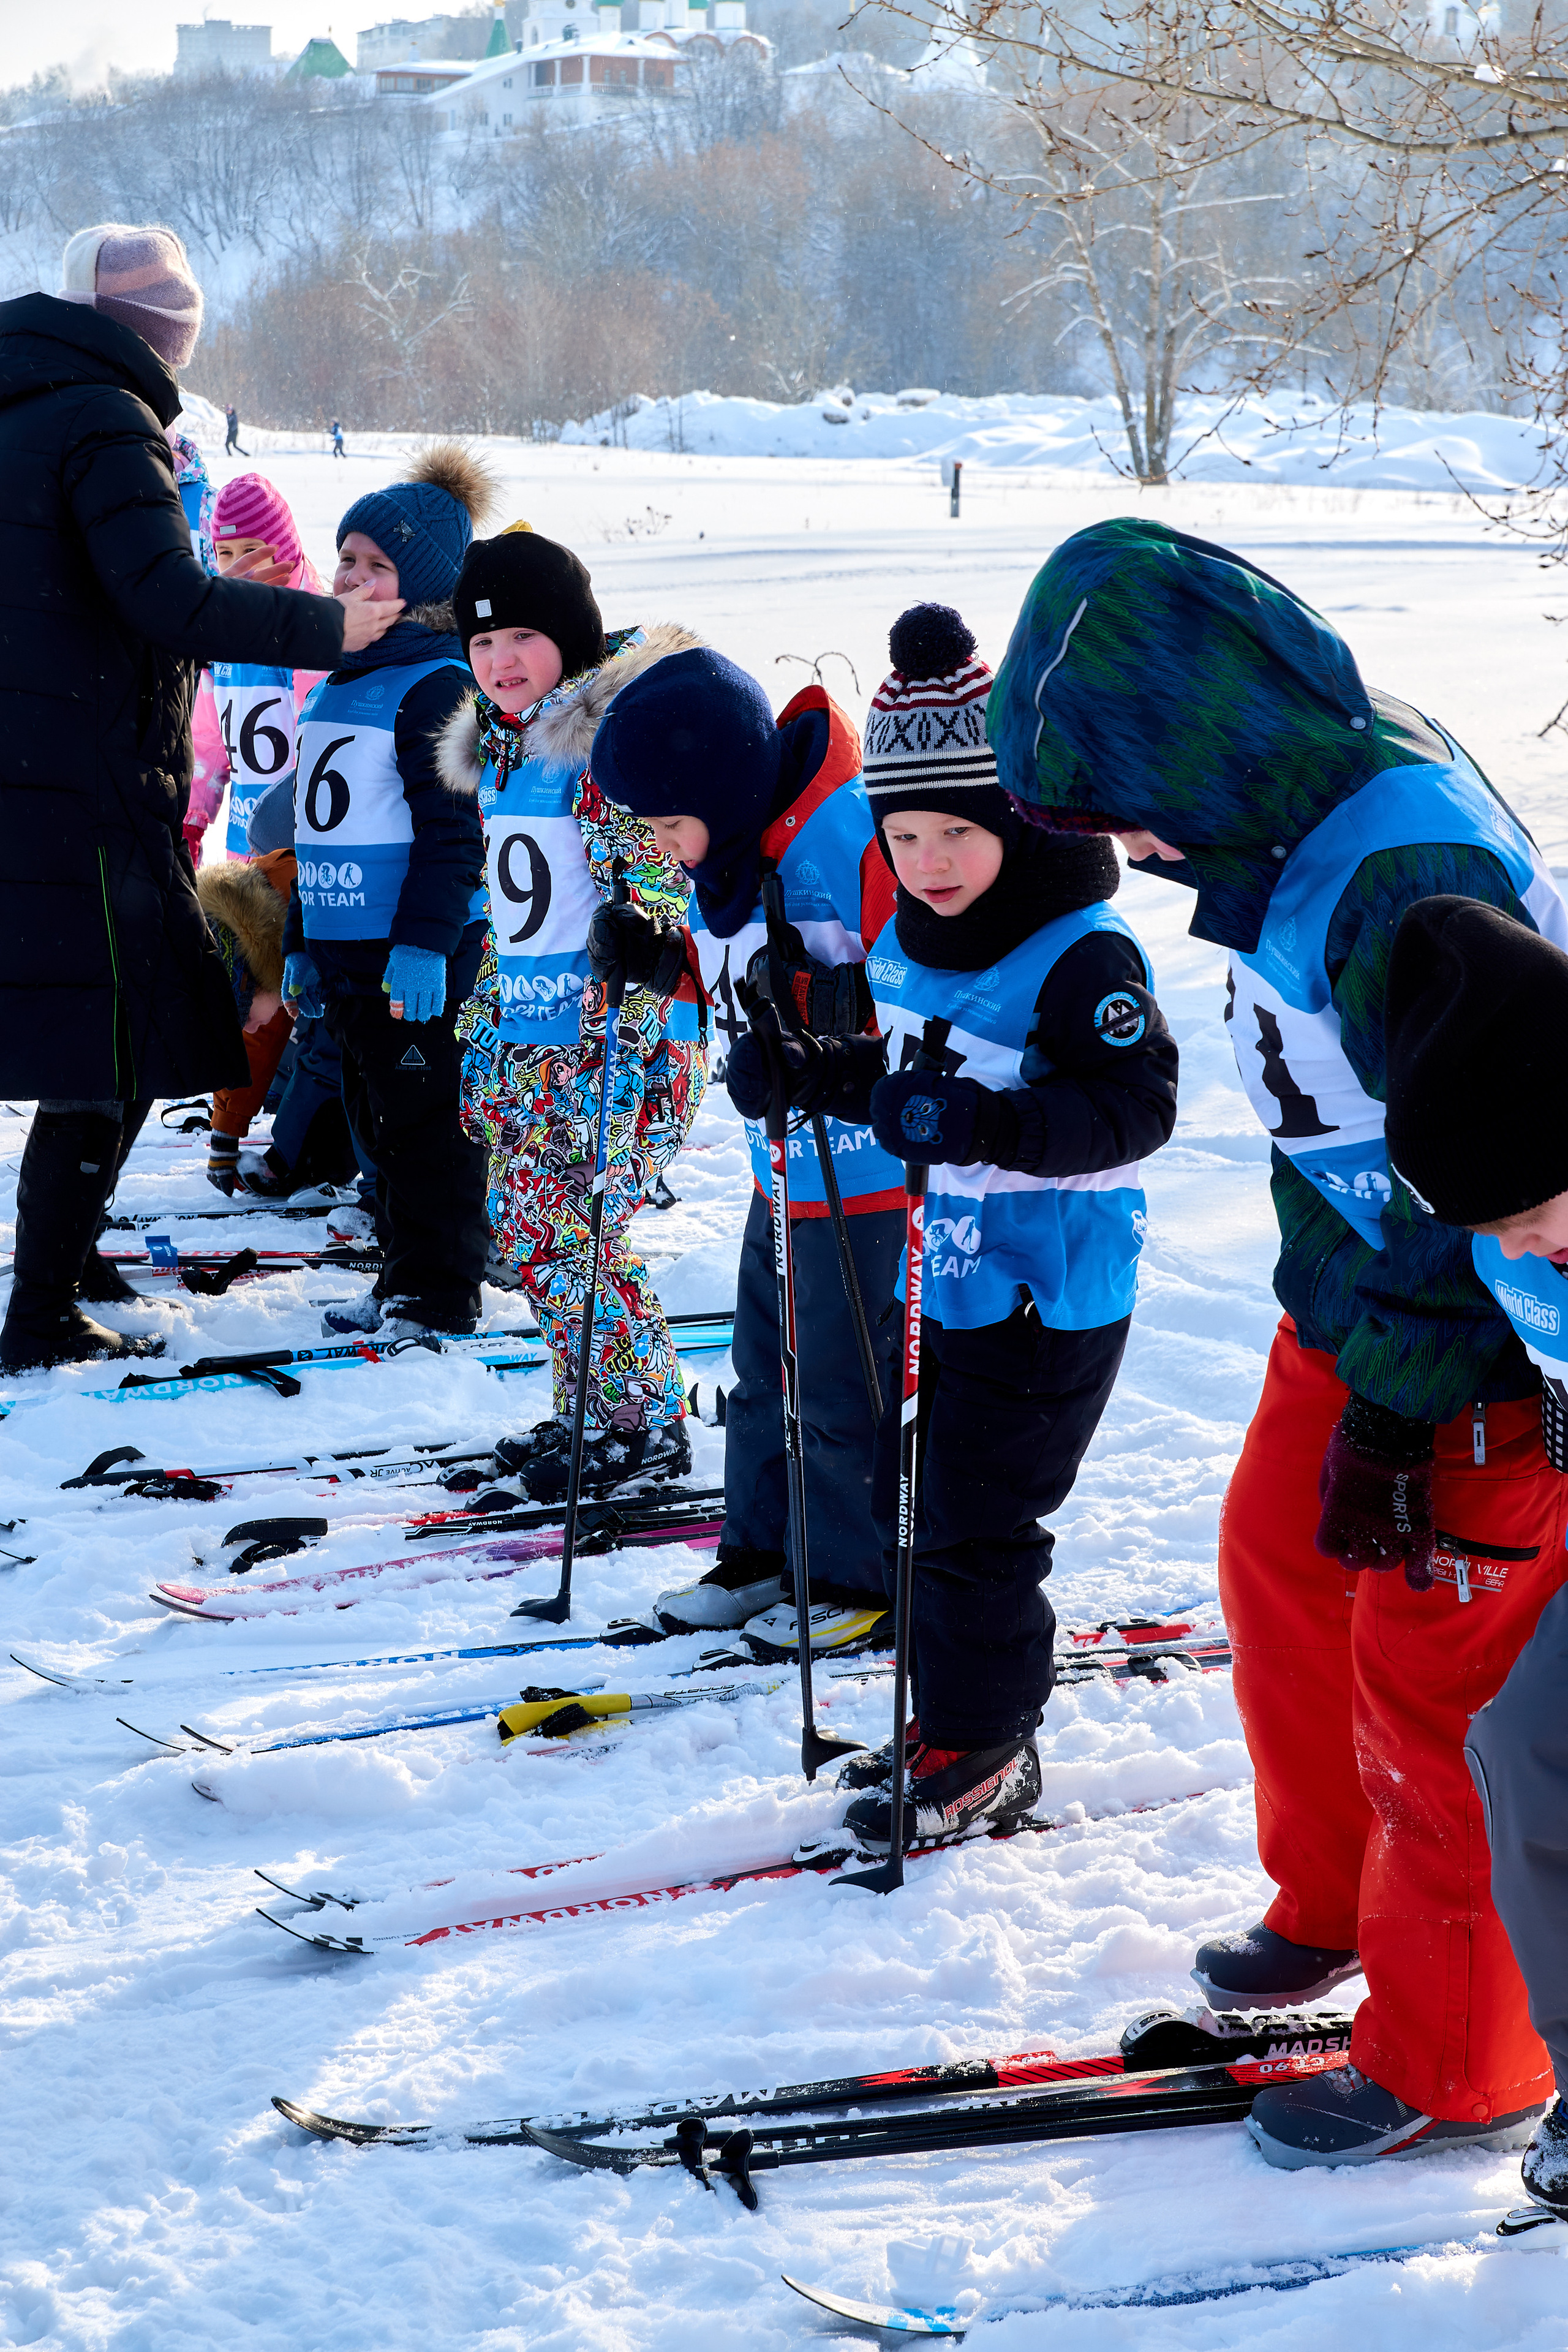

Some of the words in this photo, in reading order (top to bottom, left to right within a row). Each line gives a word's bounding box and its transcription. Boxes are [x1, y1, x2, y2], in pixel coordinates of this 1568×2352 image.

[221, 698, 289, 774] 46
[318, 892, 365, 907] TEAM
[486, 834, 551, 944] 9
[883, 963, 907, 985] Class
[772, 1178, 784, 1268] NORDWAY
[585, 1232, 597, 1294] NORDWAY
[931, 1254, 982, 1279] EAM
[909, 1245, 924, 1376] NORDWAY
[1497, 1284, 1524, 1319] World
[1524, 1297, 1557, 1331] Class
[88, 1374, 243, 1400] NORDWA
[370, 1469, 384, 1478] JR
[641, 1446, 681, 1465] NORDWAY
[899, 1472, 909, 1548] NORDWAY
[1392, 1473, 1412, 1532] SPORTS
[944, 1757, 1019, 1820] ROSSIGNOL
[1259, 2062, 1289, 2074] 90
